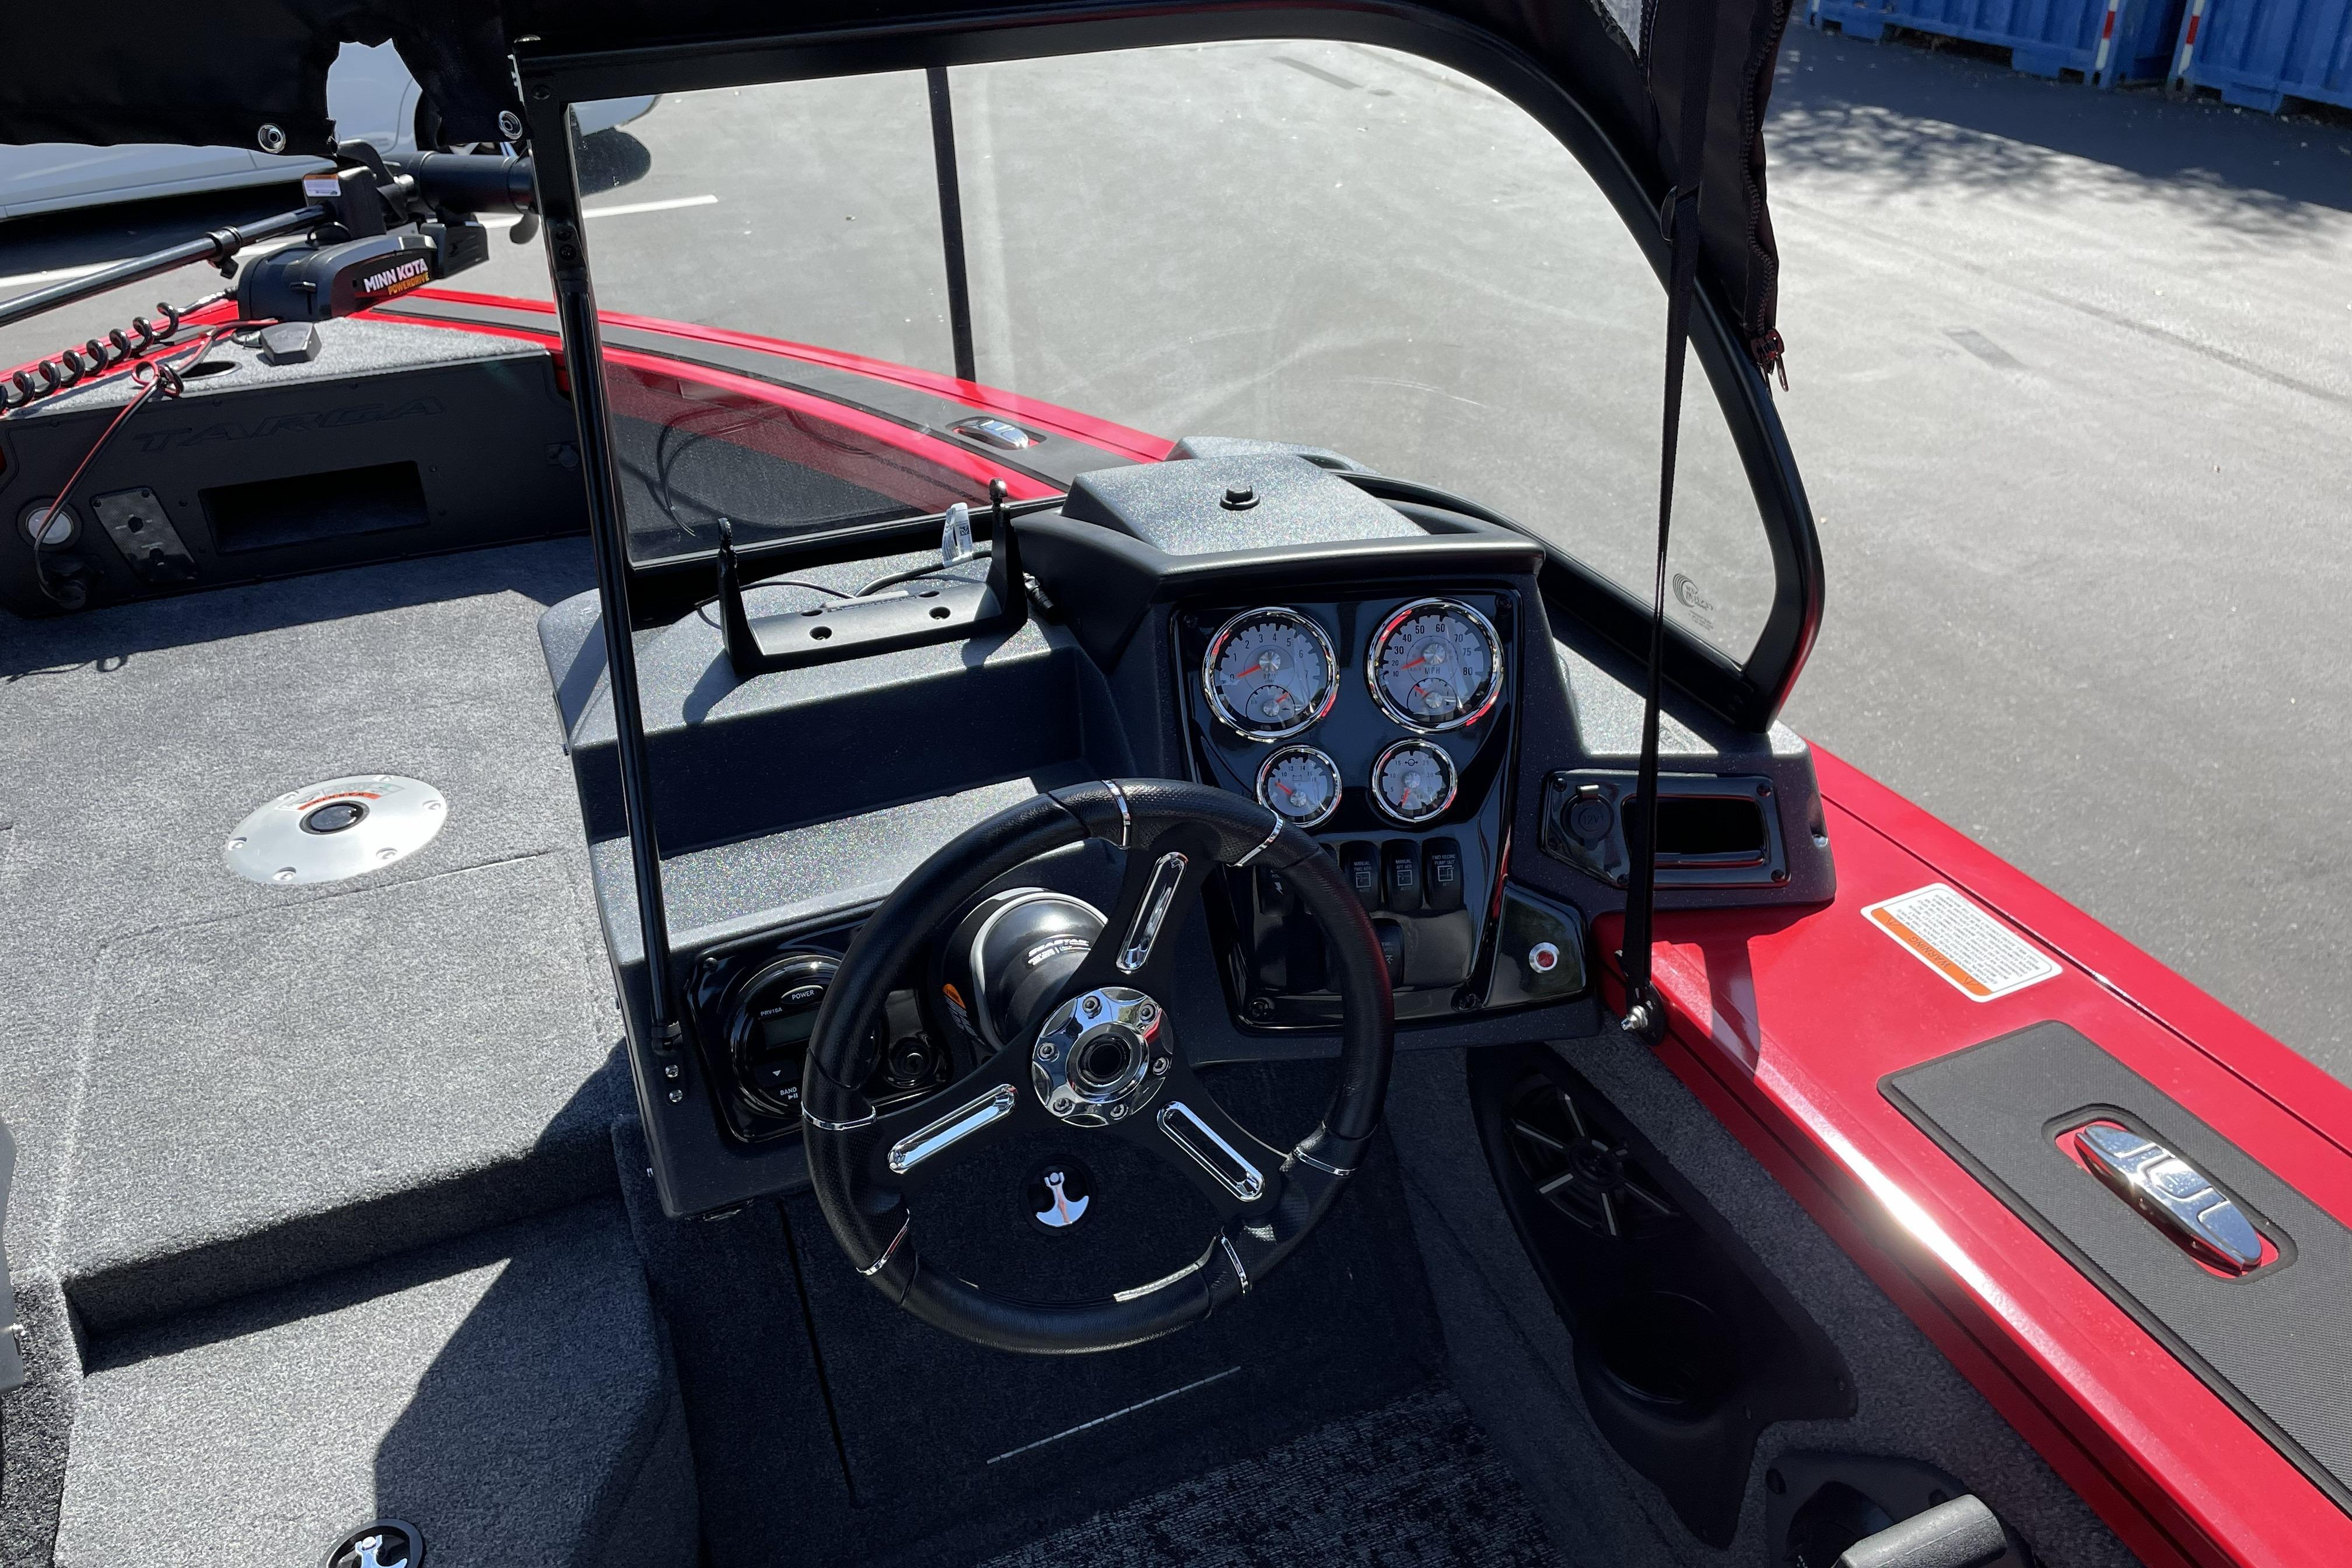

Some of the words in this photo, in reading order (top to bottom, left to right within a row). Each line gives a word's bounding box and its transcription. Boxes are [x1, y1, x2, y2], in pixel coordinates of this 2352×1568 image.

[363, 269, 397, 293] MINN
[396, 258, 429, 281] KOTA
[387, 272, 430, 296] POWERDRIVE
[134, 396, 445, 453] TARGA
[1415, 625, 1424, 634] 50
[1436, 624, 1446, 632] 60
[1259, 634, 1264, 643] 3
[1272, 633, 1277, 642] 4
[1402, 634, 1412, 642] 40
[1455, 634, 1463, 642] 70
[1245, 640, 1250, 649] 2
[1287, 638, 1292, 647] 5
[1299, 650, 1303, 658] 6
[1394, 646, 1404, 654] 30
[1462, 648, 1472, 656] 75
[1233, 653, 1237, 662] 1
[1305, 670, 1308, 679] 7
[1424, 667, 1440, 675] MPH
[1463, 667, 1473, 676] 80
[1230, 674, 1234, 682] 0
[1909, 936, 1951, 968] WARNING
[792, 989, 815, 1000] POWER
[780, 1087, 797, 1096] BAND
